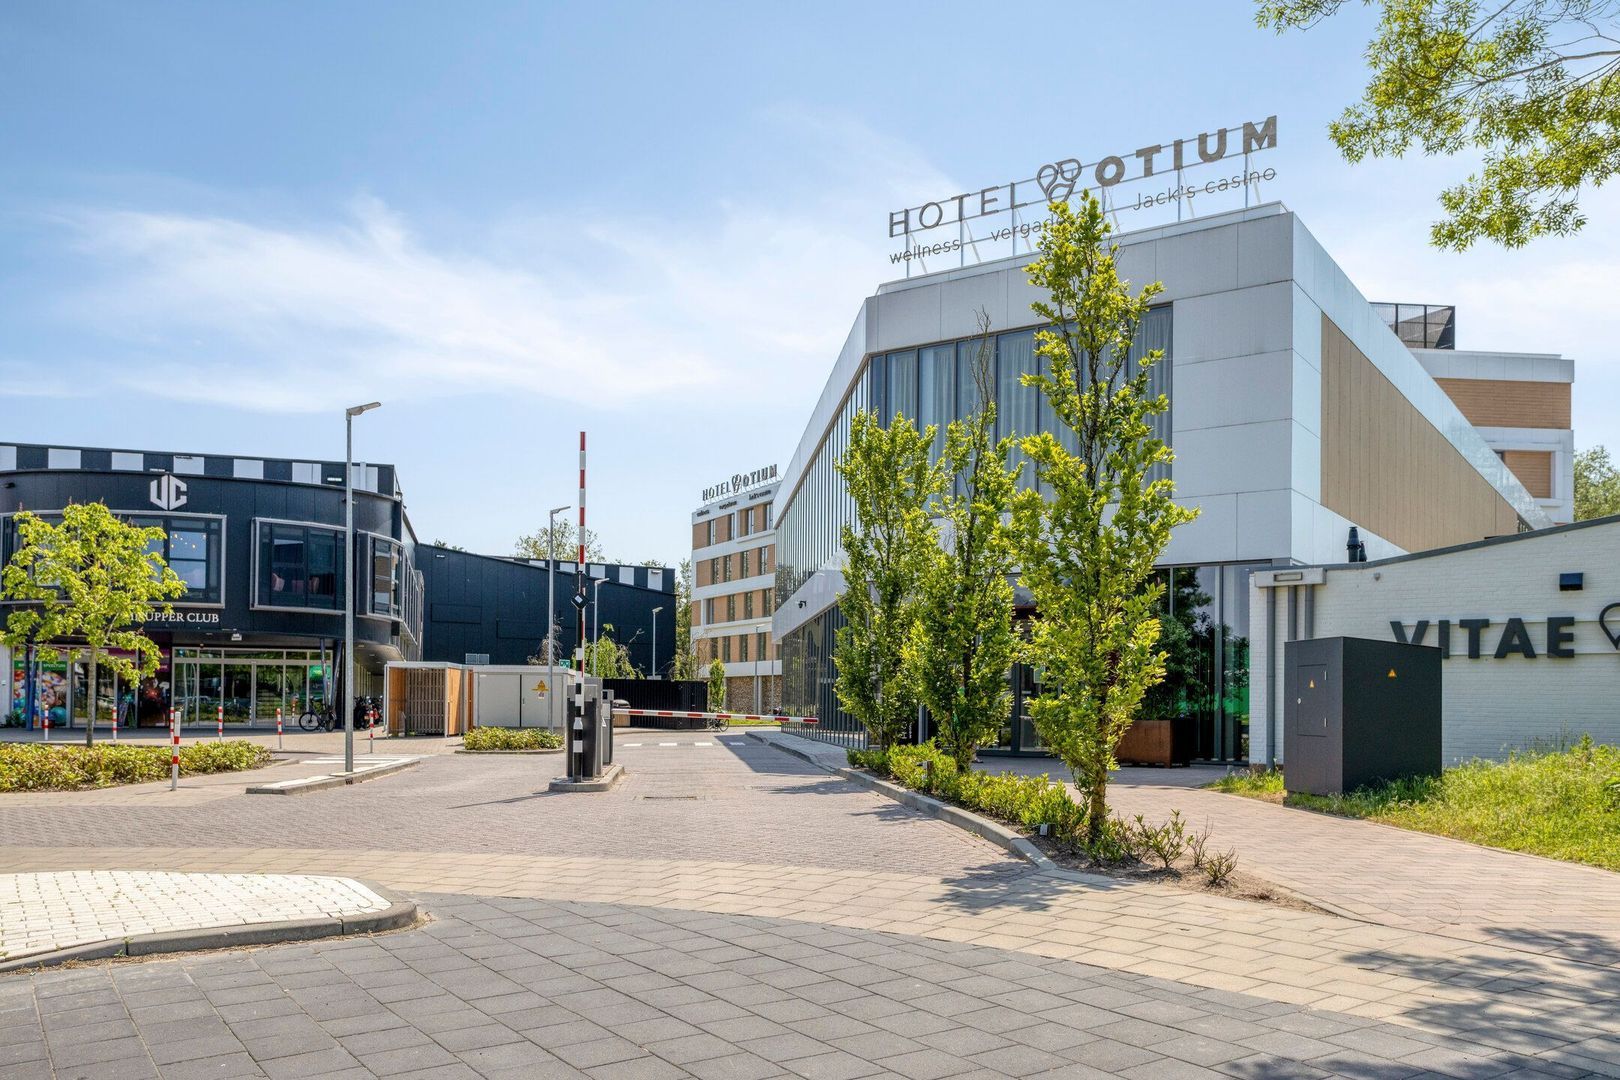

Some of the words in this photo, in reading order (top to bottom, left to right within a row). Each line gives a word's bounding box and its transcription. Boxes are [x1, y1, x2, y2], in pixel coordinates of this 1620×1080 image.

[889, 182, 1028, 238] HOTEL
[1095, 115, 1277, 187] OTIUM
[889, 239, 960, 265] wellness
[1133, 184, 1196, 211] Jack's
[1205, 168, 1276, 194] casino
[702, 481, 731, 501] HOTEL
[743, 464, 777, 487] OTIUM
[141, 612, 185, 622] UPPER
[186, 613, 219, 623] CLUB
[1390, 616, 1574, 659] VITAE
